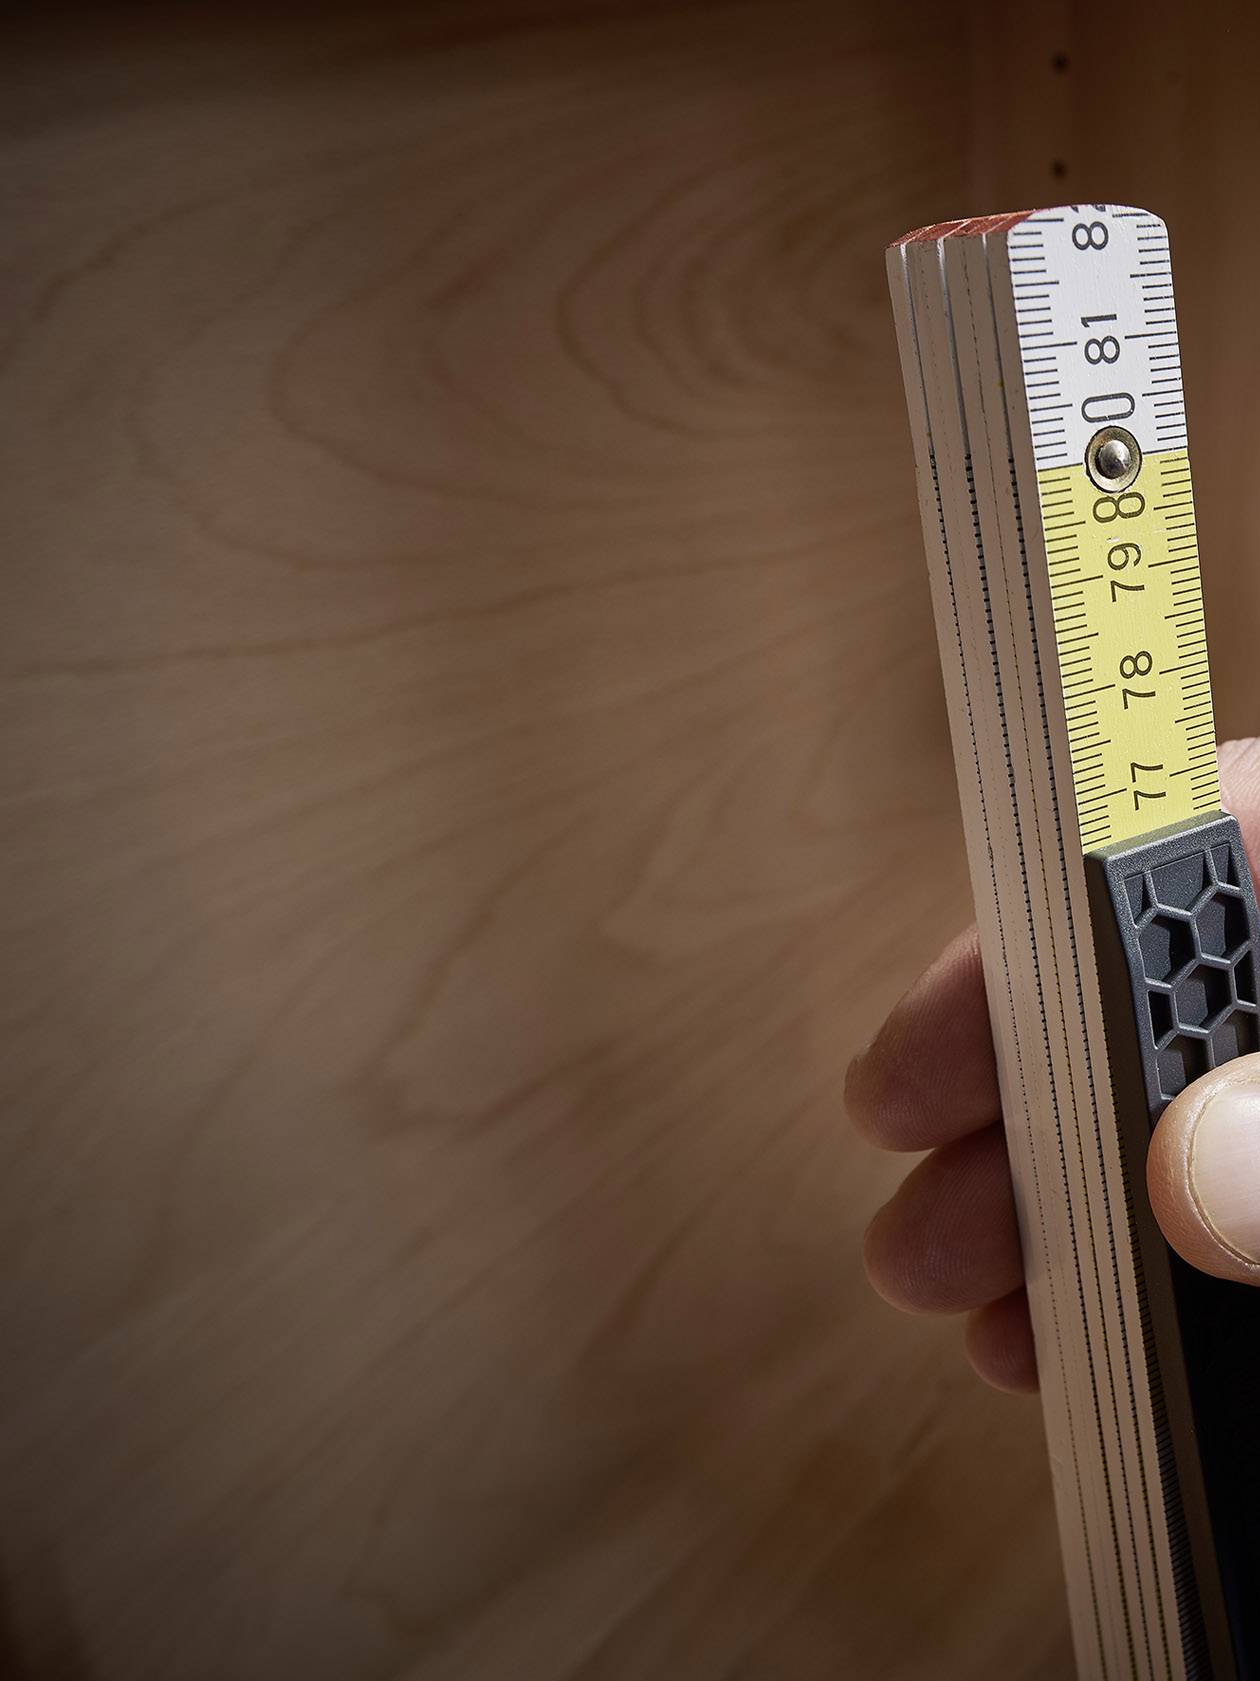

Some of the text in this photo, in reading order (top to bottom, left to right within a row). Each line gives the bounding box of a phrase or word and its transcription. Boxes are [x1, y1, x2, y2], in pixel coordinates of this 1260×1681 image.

[1071, 205, 1110, 251] 8
[1080, 313, 1121, 365] 81
[1108, 541, 1146, 604] 79
[1119, 650, 1155, 711] 78
[1130, 761, 1168, 812] 77
